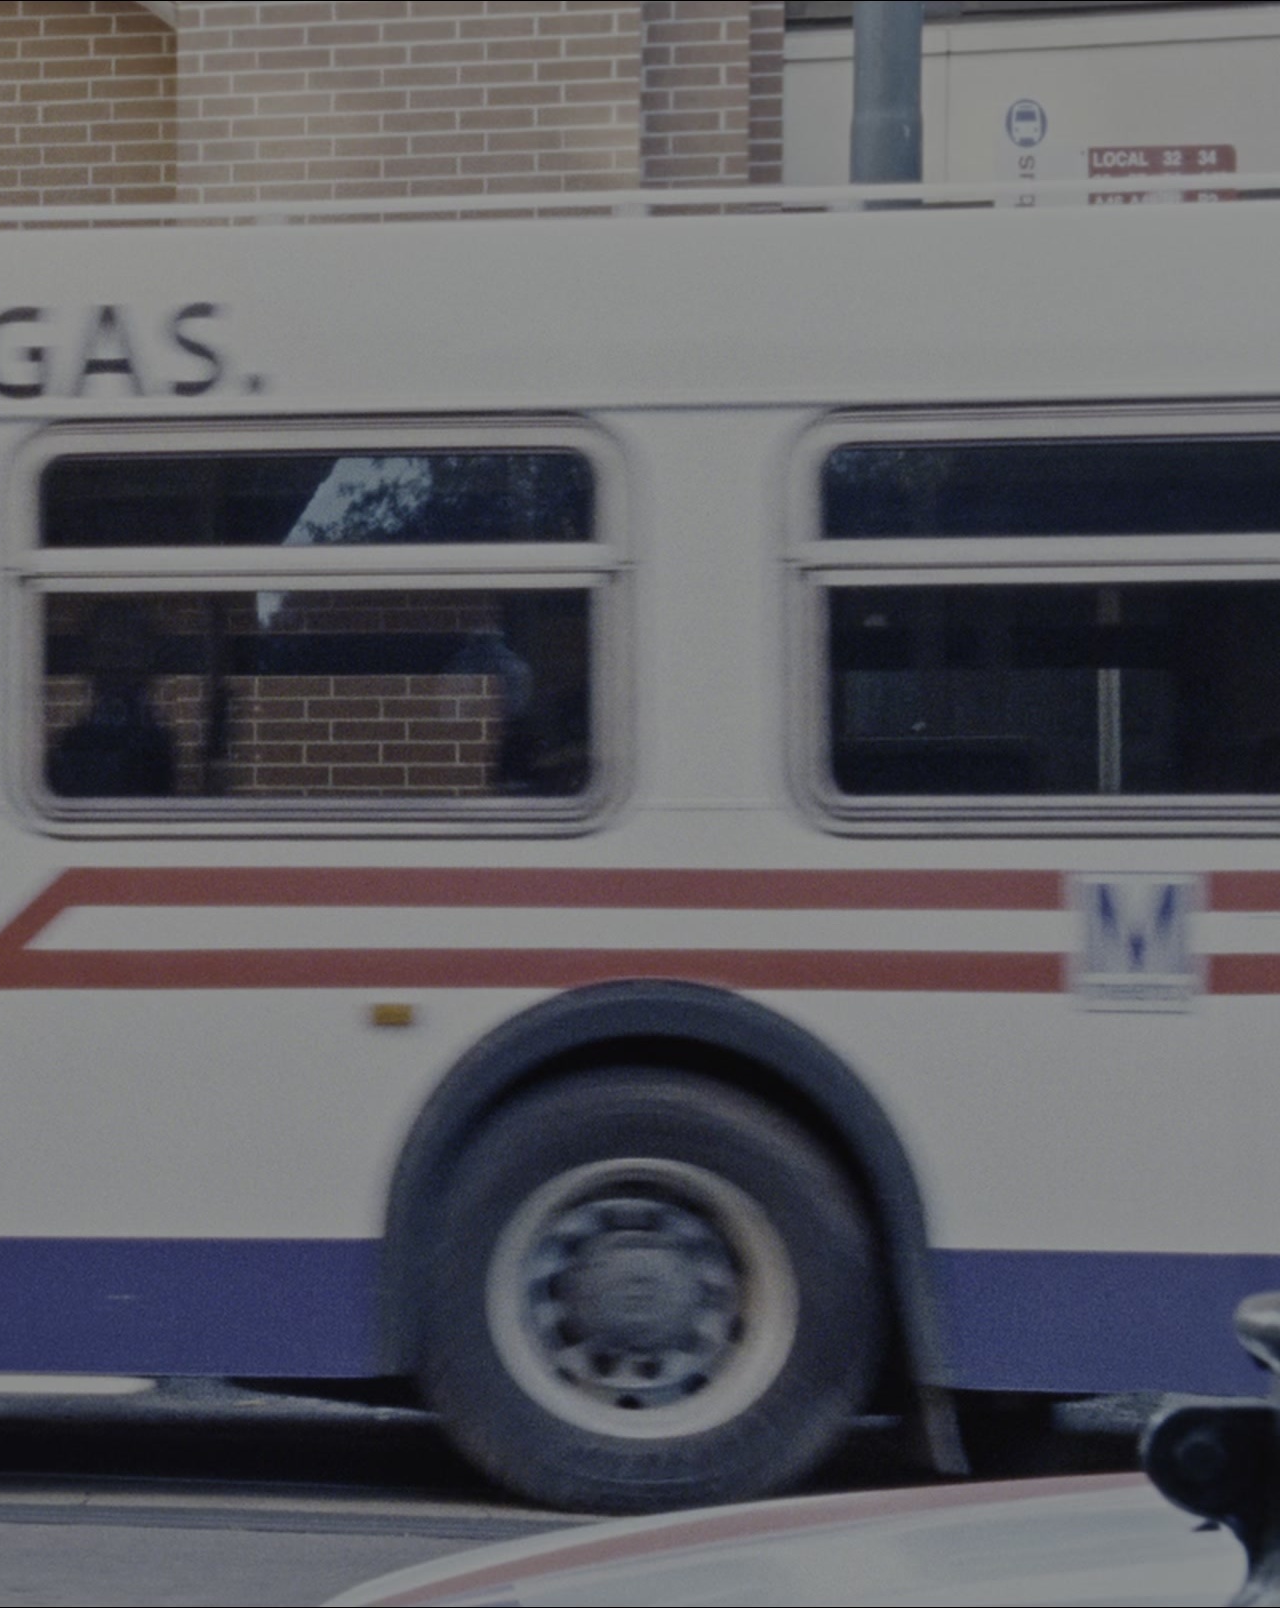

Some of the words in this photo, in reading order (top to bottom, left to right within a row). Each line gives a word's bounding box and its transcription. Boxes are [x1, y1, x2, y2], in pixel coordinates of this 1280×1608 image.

[1092, 150, 1149, 167] LOCAL
[1162, 150, 1182, 166] 32
[1197, 149, 1217, 165] 34
